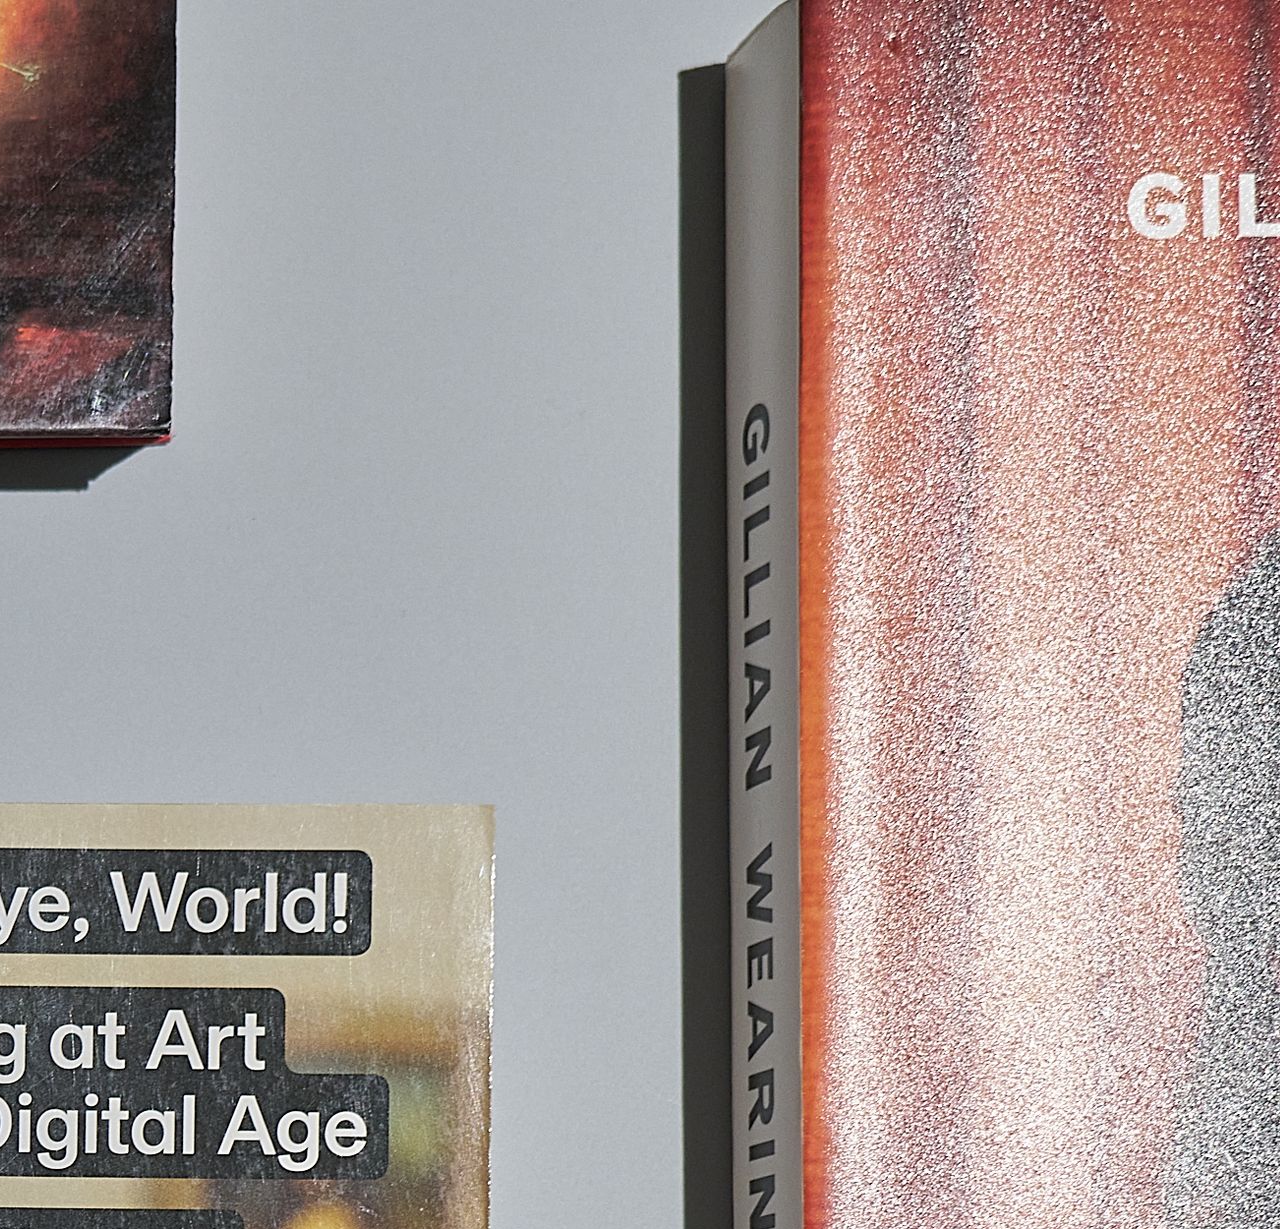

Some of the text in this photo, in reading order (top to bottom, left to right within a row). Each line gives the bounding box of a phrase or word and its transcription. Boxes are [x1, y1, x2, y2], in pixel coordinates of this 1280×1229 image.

[743, 402, 772, 790] GILLIAN
[110, 871, 350, 936] World!
[48, 1014, 127, 1071] at
[145, 1009, 268, 1072] Art
[217, 1094, 368, 1170] Age
